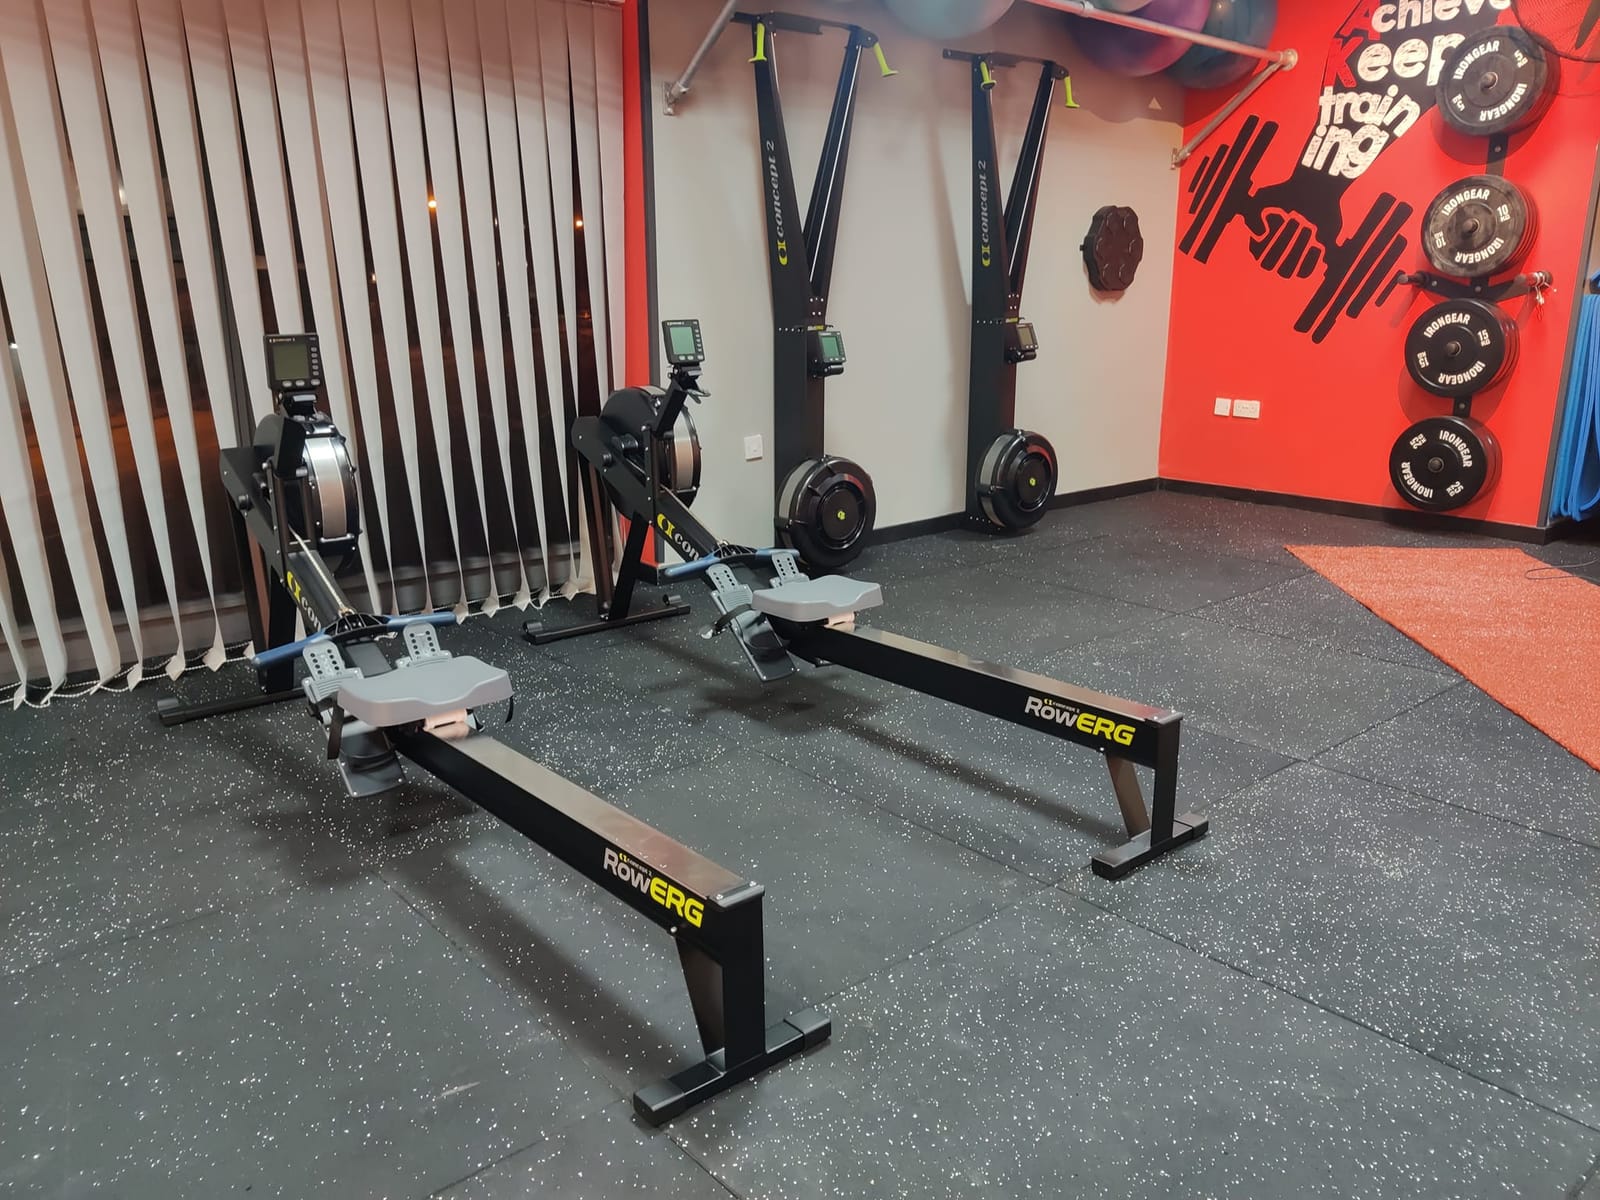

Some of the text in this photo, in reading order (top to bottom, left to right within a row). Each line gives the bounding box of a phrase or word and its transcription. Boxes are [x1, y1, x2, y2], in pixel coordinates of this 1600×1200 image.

[1453, 40, 1500, 80] IRONGEAR
[1514, 49, 1523, 61] 5
[1319, 84, 1421, 138] train
[1479, 83, 1527, 121] IRONGEAR
[1301, 124, 1390, 179] ing
[766, 140, 785, 238] concept 2
[978, 160, 990, 243] concept 2
[1441, 188, 1490, 216] IRONGEAR
[1497, 204, 1509, 217] 10
[1436, 236, 1446, 248] 10
[1454, 237, 1504, 264] IRONGEAR
[1423, 312, 1471, 339] IRONGEAR
[1477, 329, 1488, 341] 15
[1419, 356, 1429, 368] 15
[1438, 360, 1485, 385] IRONGEAR
[1410, 436, 1422, 449] 25
[1439, 430, 1472, 468] IRONGEAR
[1401, 461, 1433, 499] IRONGEAR
[1450, 481, 1464, 494] 25
[1024, 696, 1136, 746] RowERG
[603, 847, 705, 928] RowERG
